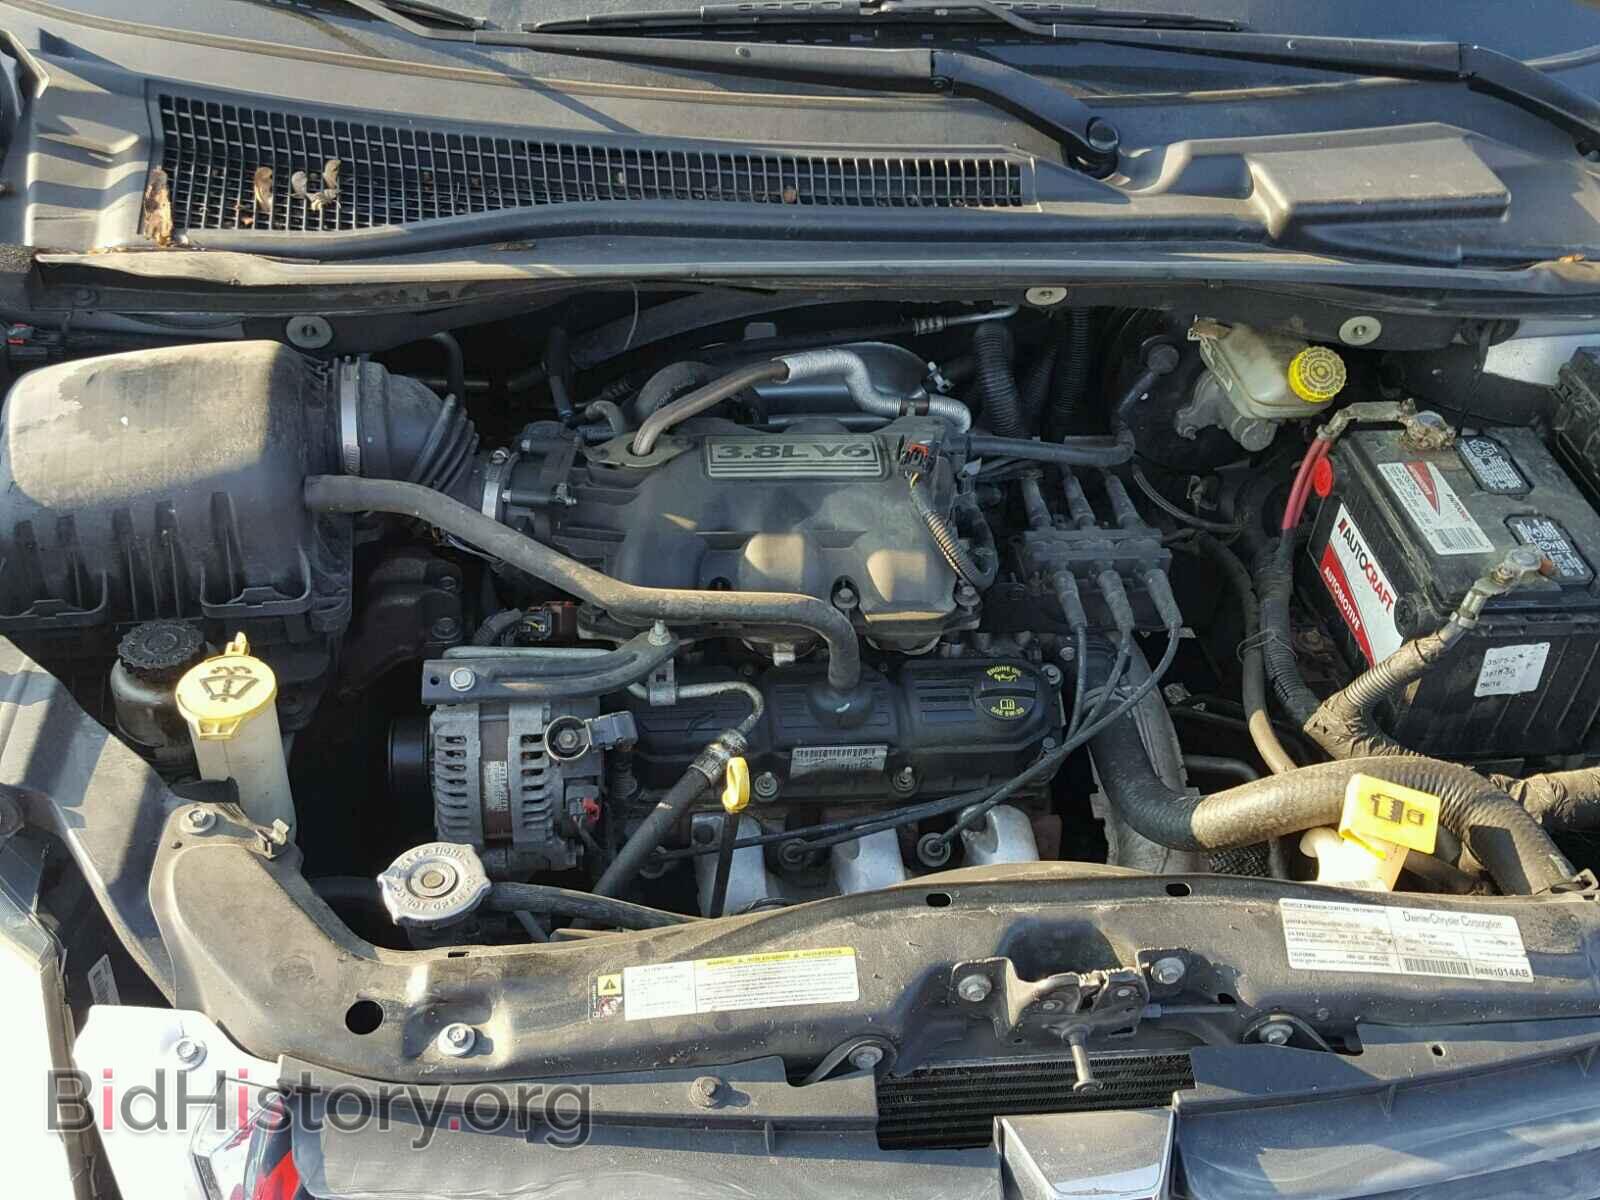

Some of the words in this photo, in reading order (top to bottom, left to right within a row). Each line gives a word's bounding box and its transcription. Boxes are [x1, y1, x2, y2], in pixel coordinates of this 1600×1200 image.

[717, 444, 809, 460] 3.8L
[812, 443, 871, 458] V6
[1342, 527, 1394, 614] AUTOCRAFT
[1323, 566, 1361, 631] AUTOMOTIVE
[987, 665, 1010, 676] ENGINE
[1461, 915, 1504, 929] Corporation
